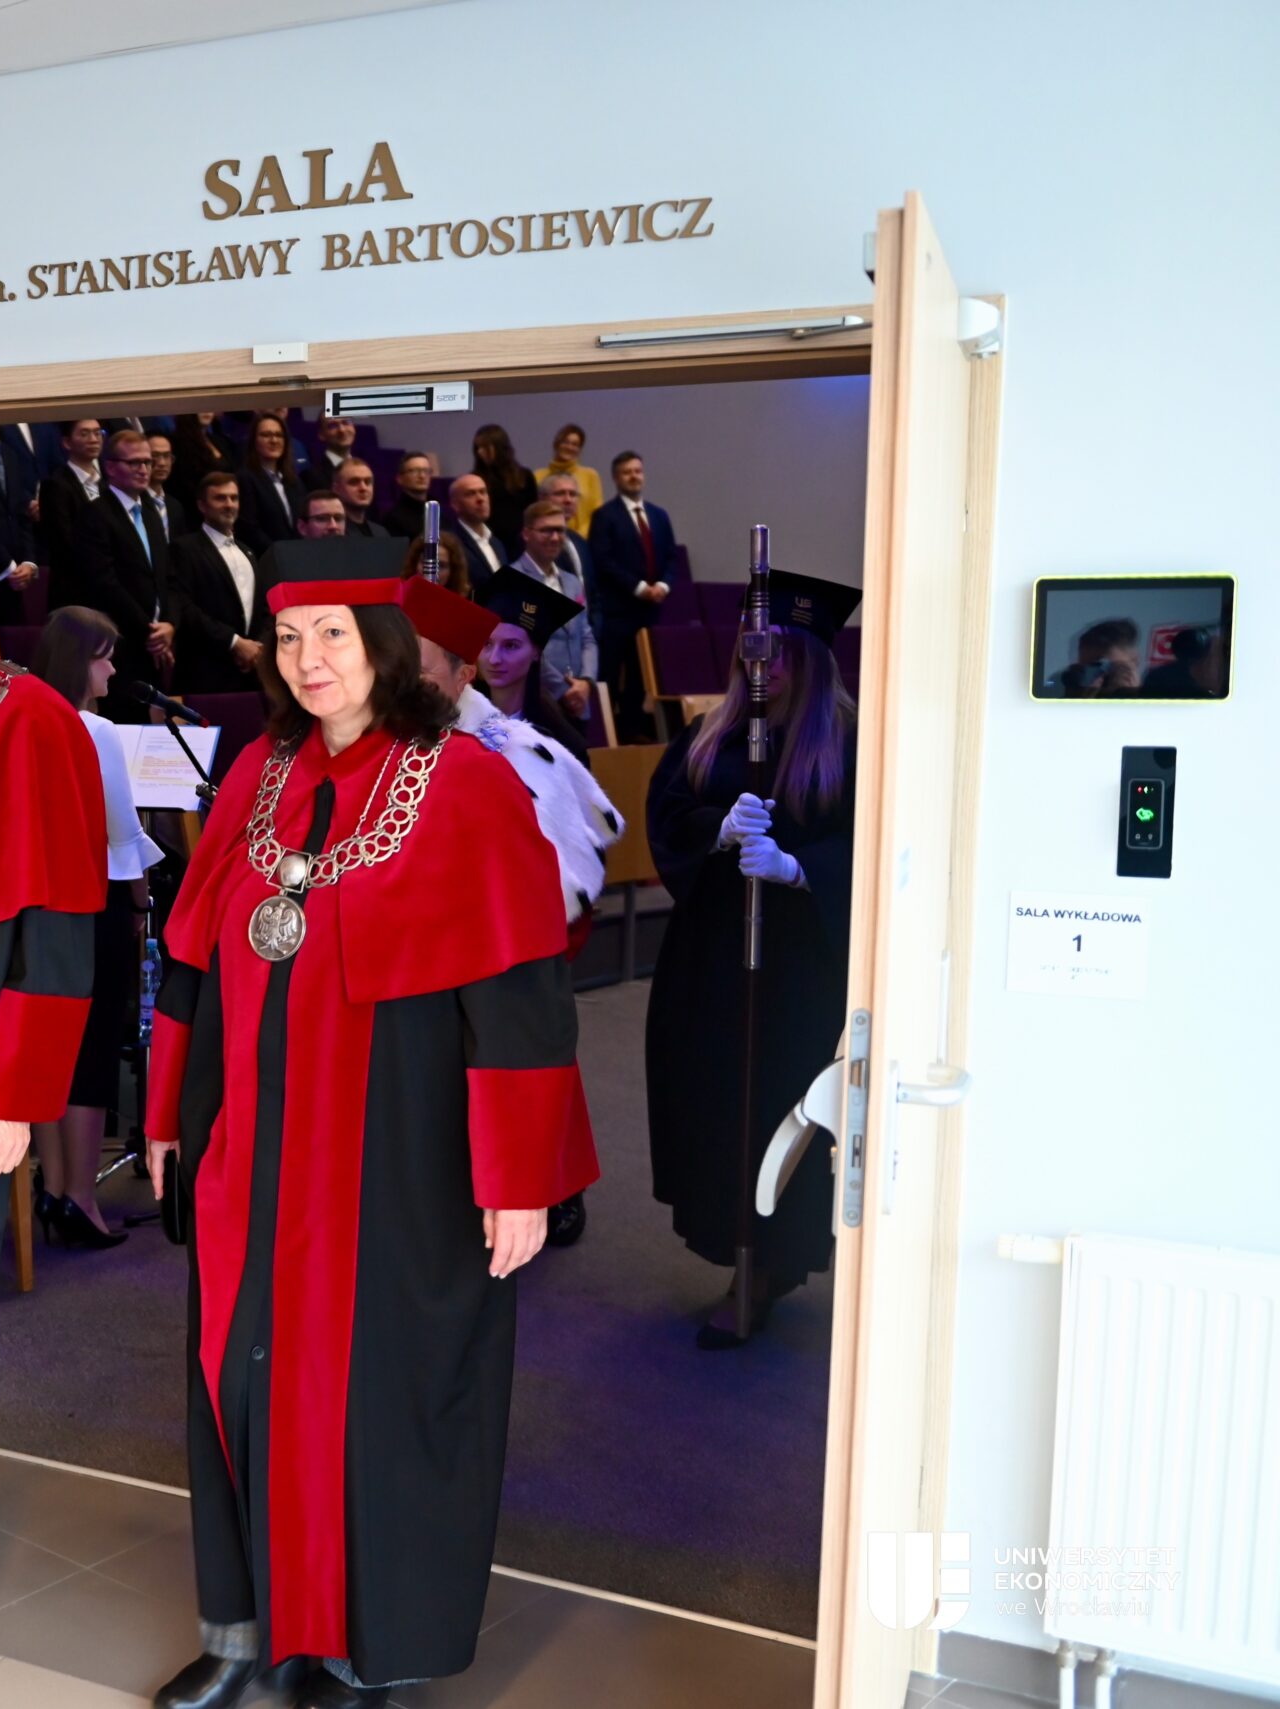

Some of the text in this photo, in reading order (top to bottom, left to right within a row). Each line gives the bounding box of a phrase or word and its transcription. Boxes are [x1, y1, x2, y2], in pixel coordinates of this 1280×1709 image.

[202, 141, 414, 221] SALA
[26, 237, 301, 300] STANISŁAWY
[320, 197, 715, 271] BARTOSIEWICZ
[1016, 906, 1142, 924] SALA WYKŁADOWA
[1072, 934, 1082, 952] 1
